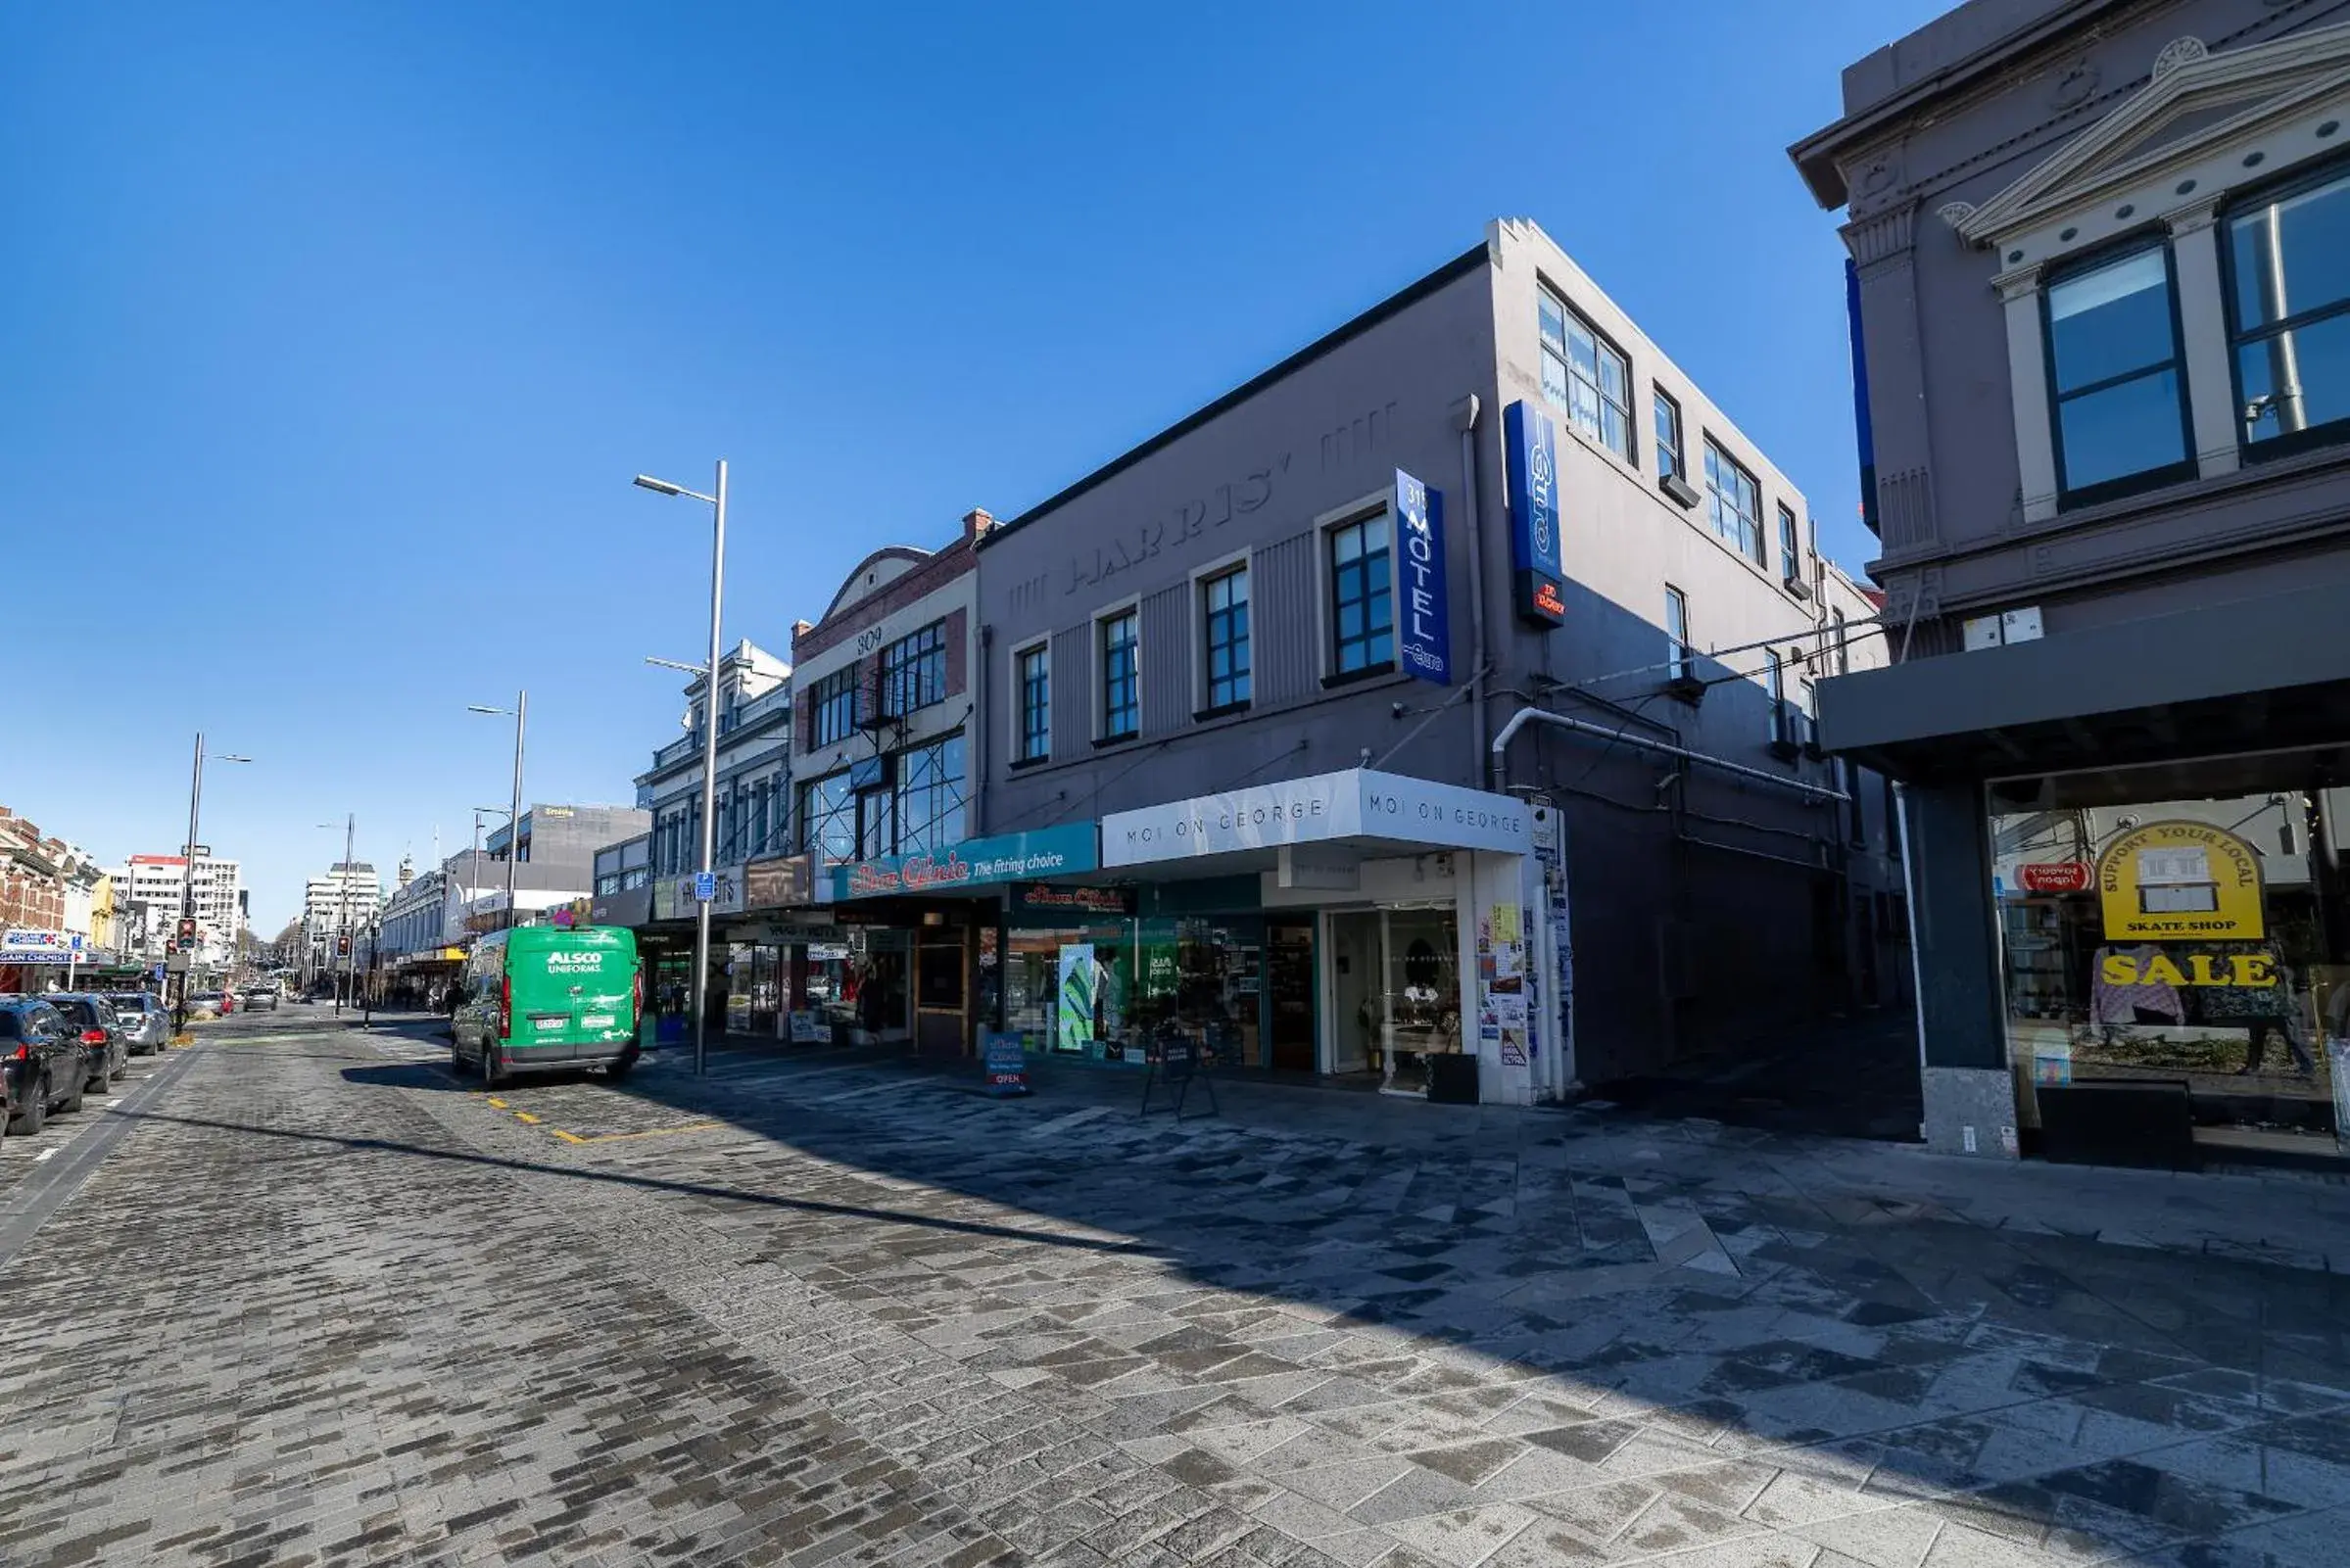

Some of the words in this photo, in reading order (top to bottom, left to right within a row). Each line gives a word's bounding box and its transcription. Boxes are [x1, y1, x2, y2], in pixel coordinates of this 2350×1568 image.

[1407, 509, 1434, 641] MOTEL
[857, 626, 882, 655] 309
[1127, 826, 1163, 844] MOI
[1175, 819, 1203, 836] ON
[1220, 799, 1324, 832] GEORGE
[1369, 795, 1407, 815] MOI
[1418, 802, 1444, 823] ON
[1455, 810, 1520, 834] GEORGE
[901, 850, 971, 890] Clinic
[974, 862, 992, 878] The
[993, 858, 1025, 877] fitting
[1026, 853, 1064, 871] choice
[2105, 832, 2149, 893] SUPPORT
[2157, 827, 2219, 844] YOUR
[2218, 838, 2254, 888] LOCAL
[2126, 921, 2184, 932] SKATE
[2188, 920, 2238, 931] SHOP
[547, 951, 602, 964] ALSCO
[548, 964, 601, 974] UNIFORMS
[2102, 953, 2278, 989] SALE
